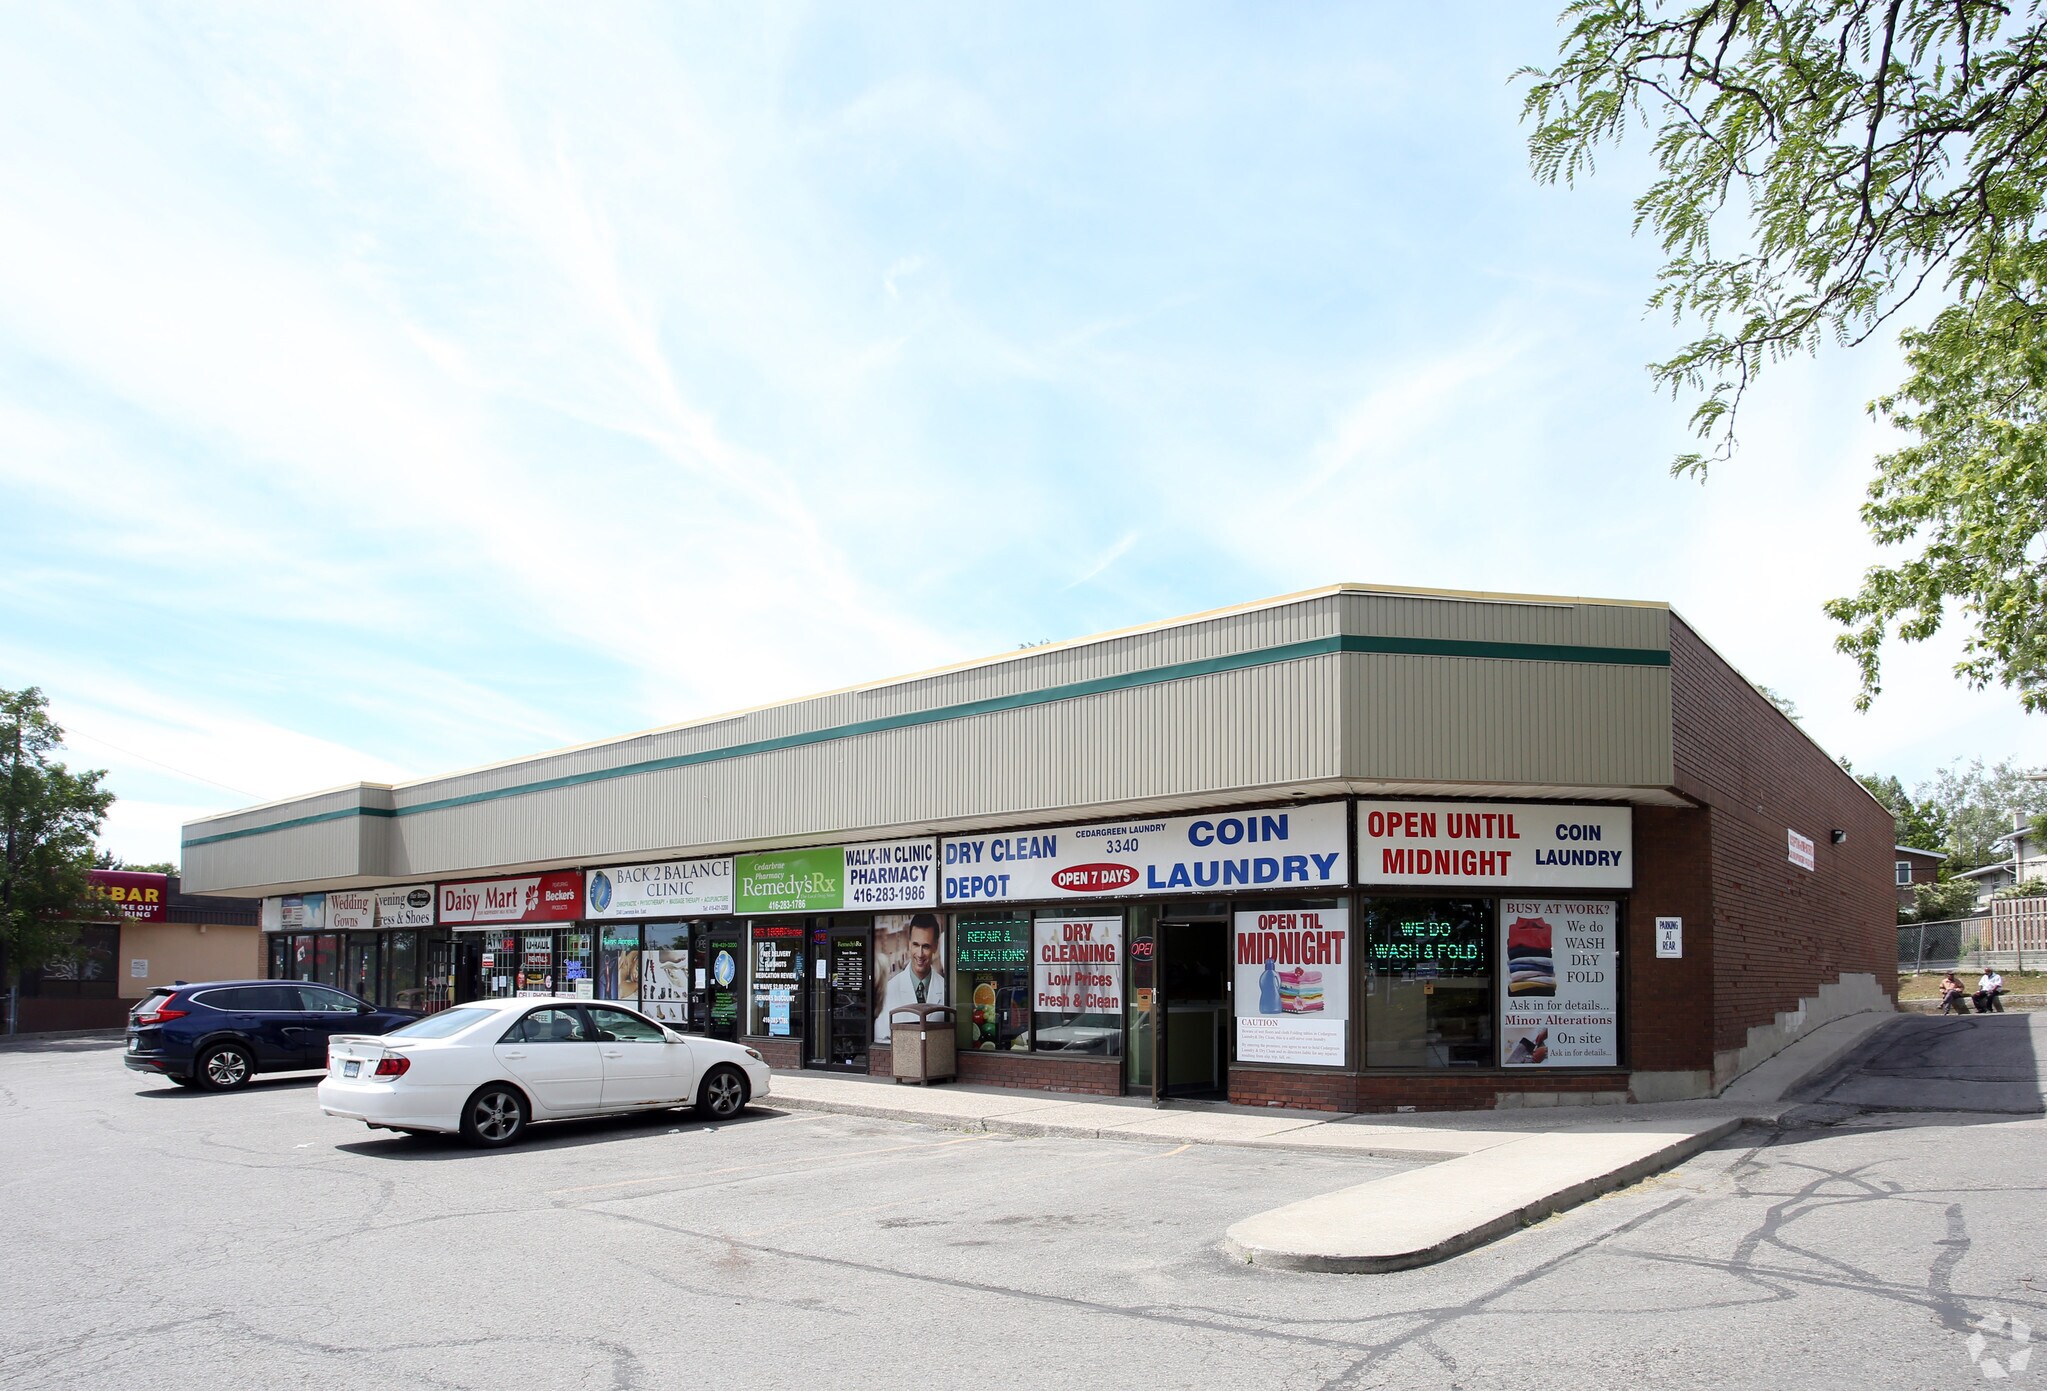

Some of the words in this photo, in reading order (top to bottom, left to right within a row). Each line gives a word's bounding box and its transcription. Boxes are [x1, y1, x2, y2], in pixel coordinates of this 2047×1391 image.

[1076, 827, 1128, 838] CEDARGREEN
[1129, 823, 1166, 835] LAUNDRY
[1188, 814, 1289, 847] COIN
[1368, 811, 1437, 838] OPEN
[1447, 812, 1520, 839] UNTIL
[1556, 824, 1601, 841] COIN
[946, 841, 985, 865] DRY
[991, 835, 1057, 861] CLEAN
[1106, 838, 1139, 854] 3340
[846, 849, 891, 867] WALK-IN
[895, 844, 932, 863] CLINIC
[1383, 849, 1512, 876] MIDNIGHT
[1535, 849, 1622, 866] LAUNDRY
[617, 868, 650, 883] BACK
[654, 866, 660, 880] 2
[664, 861, 729, 880] BALANCE
[755, 872, 784, 880] Pharmacy
[850, 865, 929, 885] PHARMACY
[1058, 870, 1088, 886] OPEN
[1091, 870, 1098, 885] 7
[1101, 868, 1131, 884] DAYS
[1147, 852, 1339, 889] LAUNDRY
[111, 887, 159, 902] BAR
[546, 889, 574, 901] Becker's
[647, 882, 693, 896] CLINIC
[854, 886, 925, 902] 416-283-1986
[946, 875, 1010, 899] DEPOT
[331, 894, 369, 915] Wedding
[446, 888, 480, 920] Daisy
[485, 887, 517, 909] Mart
[1506, 904, 1542, 915] BUSY
[1544, 904, 1562, 915] AT
[1564, 904, 1610, 915] WORK?
[334, 914, 358, 927] Gowns
[381, 915, 395, 925] ress
[397, 912, 403, 924] &
[405, 910, 429, 924] Shoes
[1258, 914, 1295, 930] OPEN
[1300, 913, 1323, 929] TIL
[1567, 920, 1585, 933] We
[1588, 920, 1604, 933] do
[1660, 921, 1678, 930] PARKING
[967, 931, 1001, 942] REPAIR
[1063, 924, 1093, 941] DRY
[1401, 922, 1424, 936] WE
[1429, 922, 1451, 936] DO
[1666, 931, 1672, 940] AT
[1238, 931, 1345, 965] MIDNIGHT
[1374, 944, 1421, 960] WASH
[1424, 944, 1433, 959] &
[1438, 944, 1477, 959] FOLD
[1565, 938, 1605, 950] WASH
[1663, 941, 1675, 950] REAR
[1042, 944, 1115, 962] CLEANING
[1571, 955, 1600, 966] DRY
[1048, 972, 1071, 986] Low
[1075, 972, 1112, 986] Prices
[1567, 972, 1604, 983] FOLD
[1039, 993, 1069, 1007] Fresh
[1073, 994, 1082, 1007] &
[1086, 993, 1118, 1008] Clean
[1510, 1000, 1530, 1011] Ask
[1534, 1000, 1545, 1011] in
[1547, 1000, 1561, 1011] for
[1563, 1000, 1610, 1011] details...
[1505, 1015, 1542, 1025] Minor
[1545, 1015, 1612, 1025] Alterations
[1557, 1032, 1576, 1044] On
[1579, 1032, 1602, 1044] site
[1550, 1049, 1563, 1057] Ask
[1564, 1049, 1572, 1057] in
[1572, 1049, 1582, 1057] for
[1583, 1049, 1612, 1057] details...
